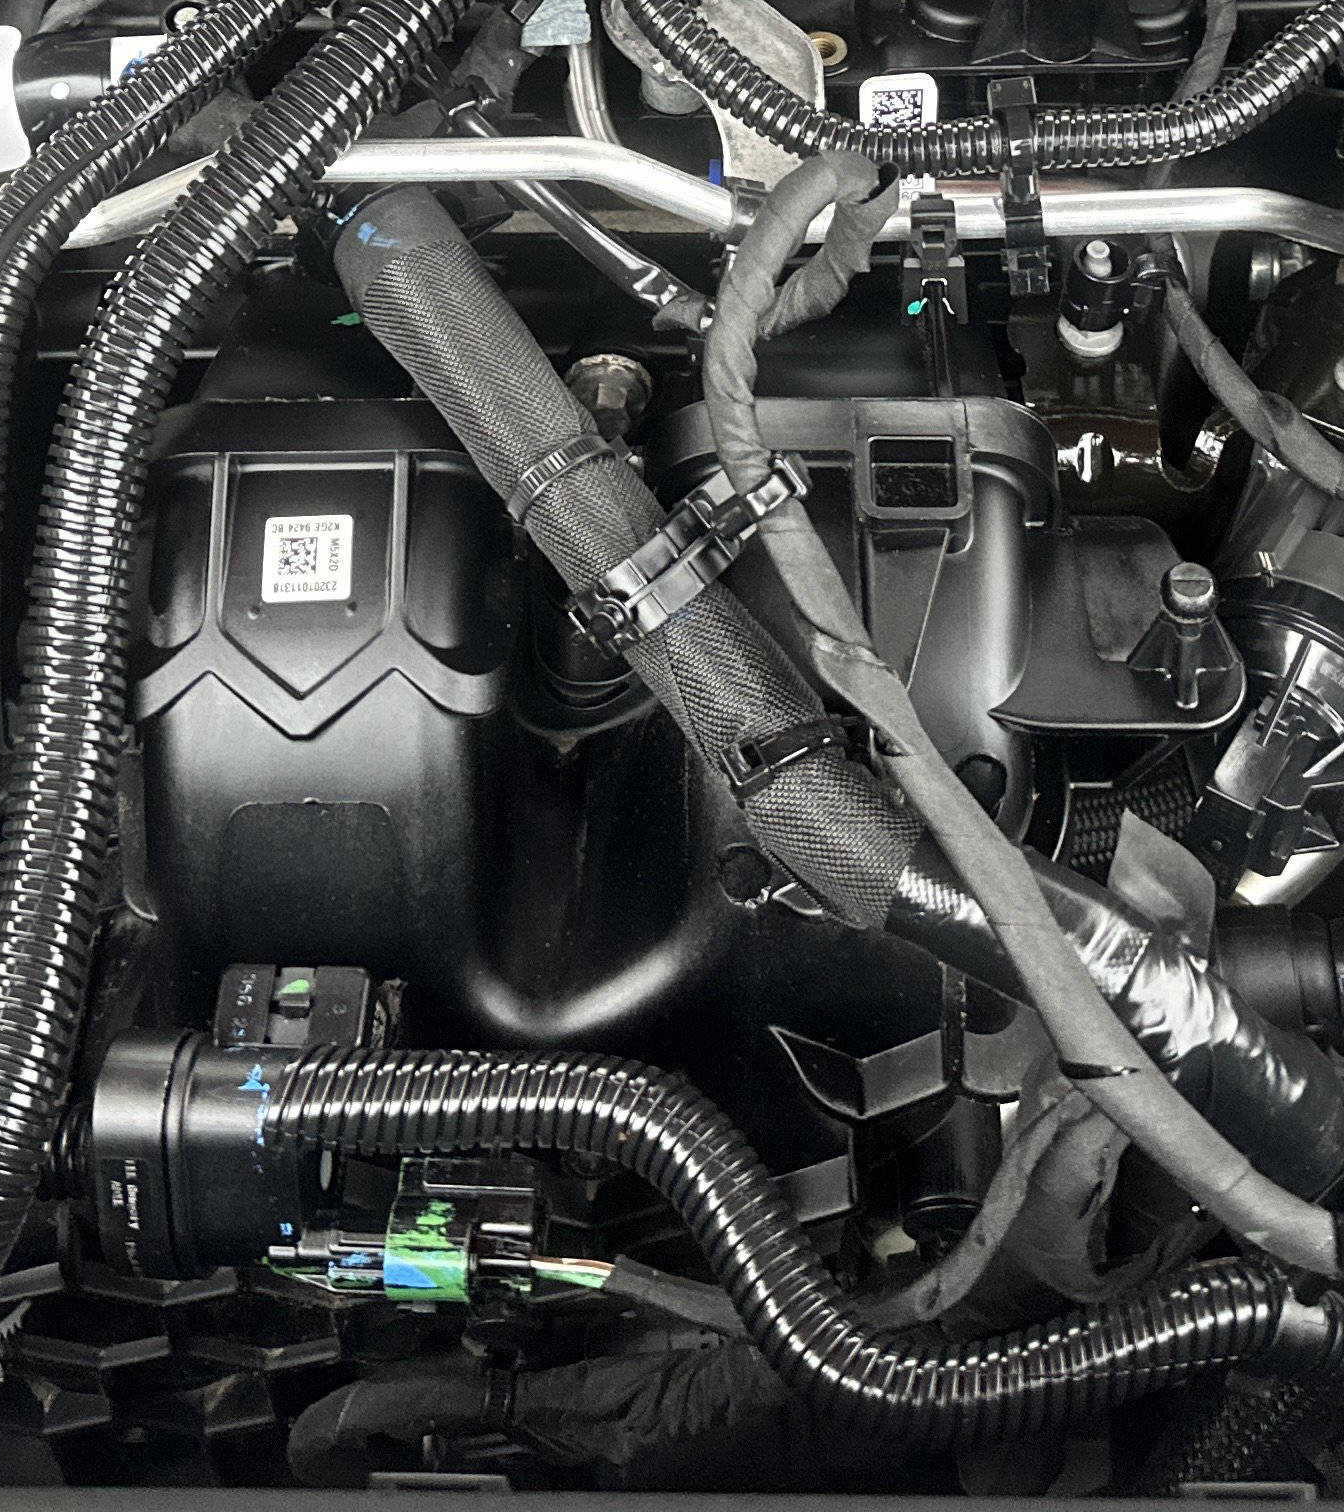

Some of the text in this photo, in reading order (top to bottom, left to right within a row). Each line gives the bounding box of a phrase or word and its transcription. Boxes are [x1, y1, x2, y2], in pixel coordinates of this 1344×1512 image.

[271, 522, 340, 533] K2GE 9424 BC
